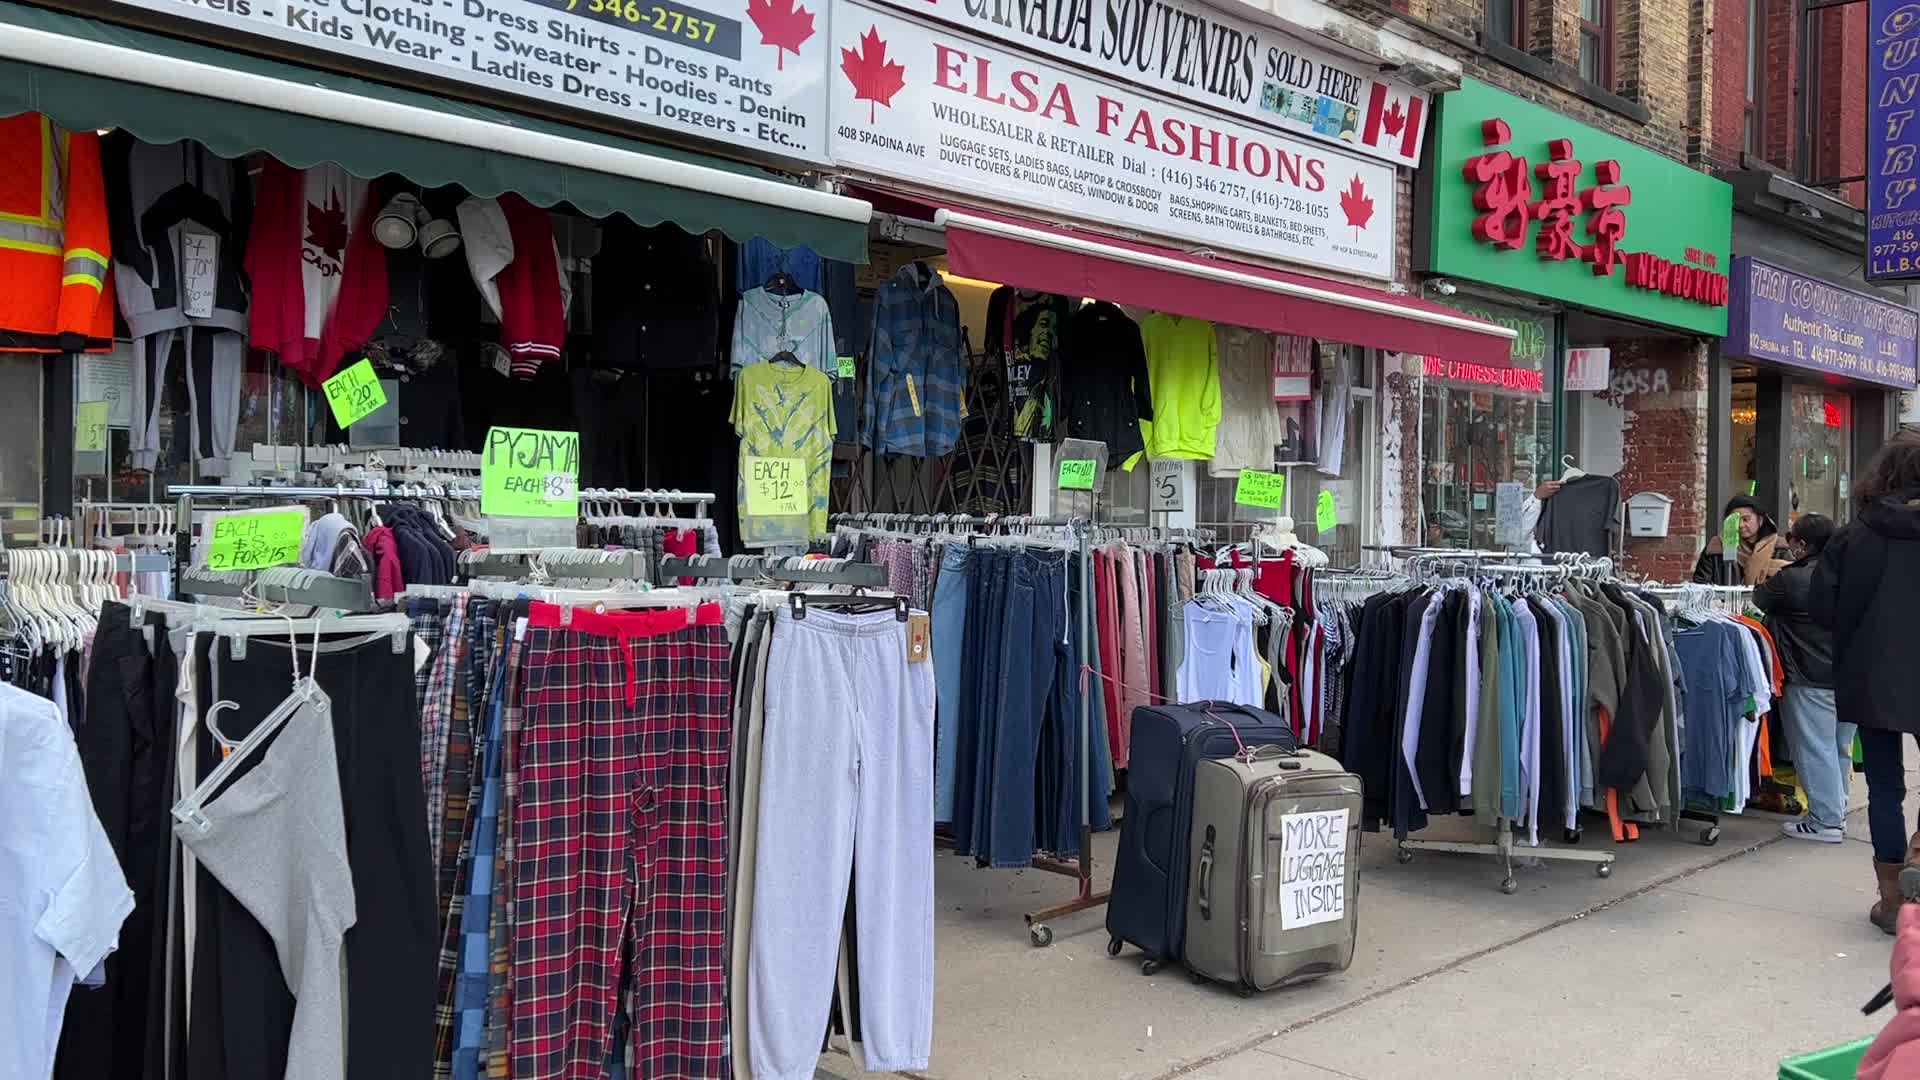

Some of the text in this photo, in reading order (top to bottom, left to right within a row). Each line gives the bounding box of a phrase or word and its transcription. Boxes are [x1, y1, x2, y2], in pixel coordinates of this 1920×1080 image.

[342, 0, 466, 46] Clothing
[494, 30, 602, 74] Sweater
[625, 64, 718, 105] Hoodies
[739, 94, 806, 128] Denim
[464, 0, 539, 34] Dress
[548, 19, 620, 55] Shirts
[645, 45, 708, 79] Dress
[715, 64, 773, 96] Pants
[1099, 0, 1259, 104] SOUVENIRS
[1264, 46, 1313, 90] SOLD
[1316, 63, 1363, 106] HERE
[287, 5, 353, 41] Kids
[363, 23, 442, 61] Wear
[471, 50, 554, 88] Ladies
[562, 73, 632, 107] Dress
[757, 122, 808, 150] Etc...
[932, 42, 1326, 193] ELSA FASHIONS
[837, 125, 926, 158] 408 SPADINA AVE
[932, 102, 1034, 146] WHOLESALER
[1036, 131, 1048, 149] &
[1050, 134, 1115, 167] RETAILER
[1122, 155, 1146, 177] Dial
[1161, 165, 1193, 191] (416)
[1195, 175, 1217, 194] 546
[939, 133, 987, 156] LUGGAGE
[988, 145, 1014, 165] SETS,
[1014, 152, 1045, 171] LADIES
[1046, 160, 1072, 179] BAGS,
[1074, 167, 1106, 187] LAPTOP
[1107, 177, 1114, 189] &
[1115, 179, 1162, 202] CROSSBODY
[1229, 207, 1253, 223] CARTS,
[1254, 213, 1289, 231] BLANKETS,
[1289, 220, 1303, 232] BED
[939, 148, 972, 169] DUVET
[973, 157, 1011, 178] COVERS
[1012, 167, 1022, 179] &
[1023, 169, 1056, 188] PILLOW
[1057, 178, 1086, 197] CASES,
[1087, 186, 1126, 206] WINDOW
[1126, 196, 1134, 208] &
[1135, 198, 1159, 213] DOOR
[1169, 207, 1203, 225] SCREENS,
[1204, 213, 1224, 227] BATH
[1225, 218, 1254, 236] TOWELS
[1254, 224, 1260, 236] &
[1874, 241, 1920, 257] 977-59
[1892, 228, 1914, 241] 416
[1634, 252, 1728, 306] NEW HO KING
[1751, 264, 1917, 338] THAI COUNTRY KITCHEN
[1782, 311, 1864, 350] Authentic Thai Cuisine
[327, 369, 360, 400] EACH
[1447, 360, 1499, 385] CHINESE
[1501, 368, 1544, 394] CUISINE
[489, 429, 578, 475] PYJAMA
[754, 461, 791, 480] EACH
[504, 475, 540, 493] EACH
[214, 519, 260, 539] EACH
[213, 553, 229, 569] 2
[232, 550, 260, 567] FOR
[1285, 814, 1343, 851] MORE
[1281, 850, 1345, 885] LUGGAGE
[1293, 883, 1343, 920] INSIDE
